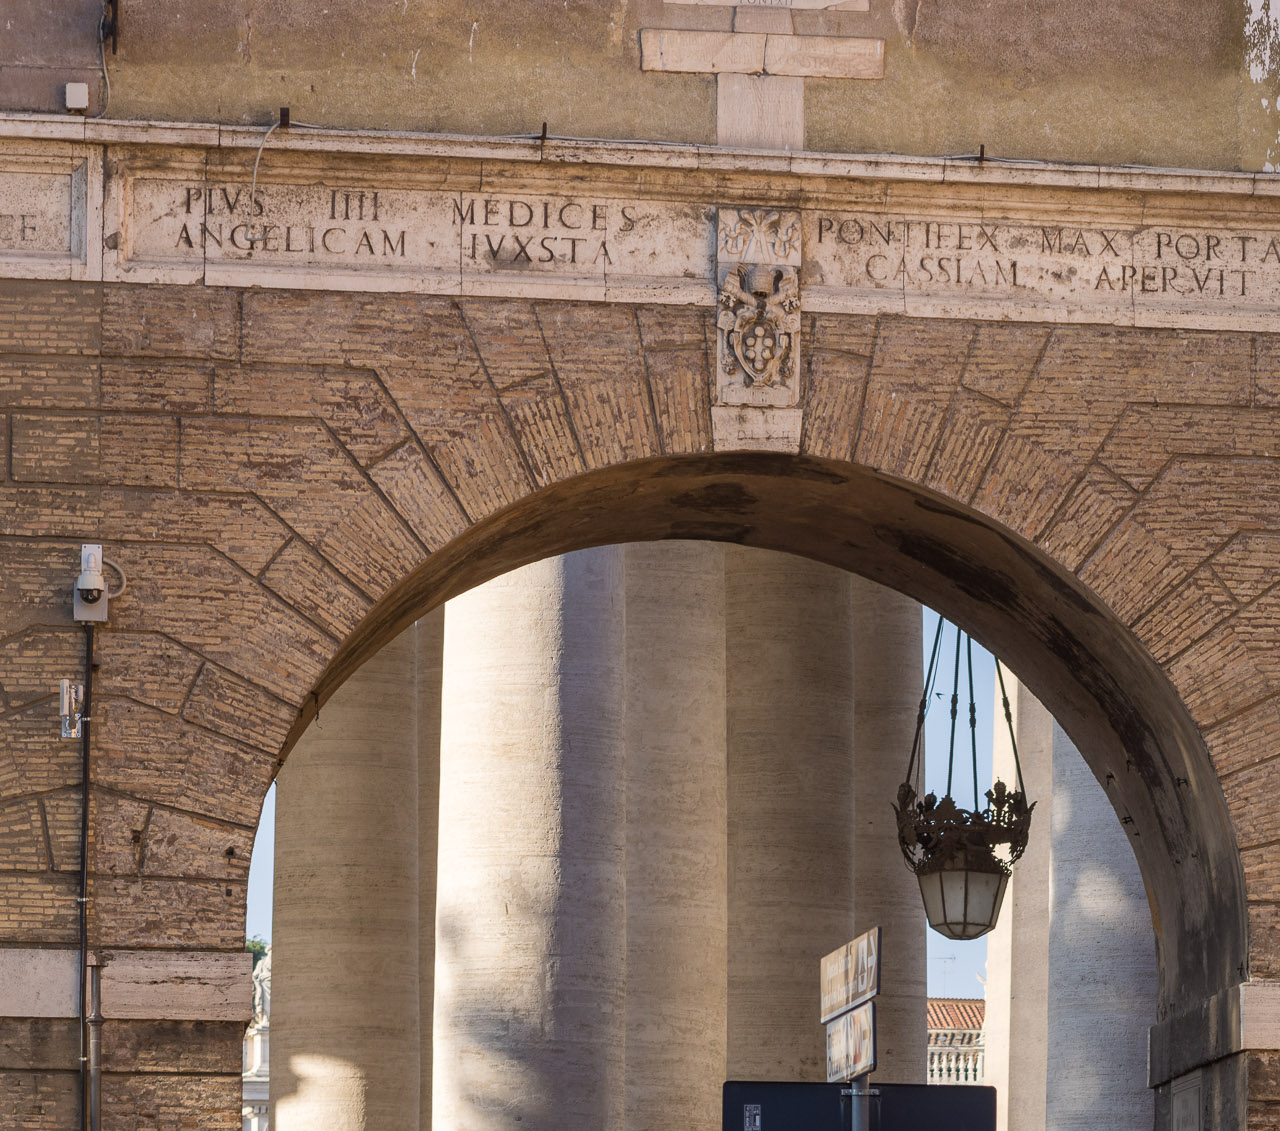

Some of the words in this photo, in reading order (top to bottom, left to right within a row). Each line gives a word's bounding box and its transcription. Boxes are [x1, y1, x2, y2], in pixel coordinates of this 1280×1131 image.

[184, 187, 264, 217] PIVS
[452, 198, 636, 232] MEDICES
[175, 222, 407, 257] ANGELICAM
[470, 233, 613, 265] IVXSTA
[817, 217, 1001, 252] PONTIFEX
[1040, 227, 1120, 257] MAX
[865, 254, 1018, 287] CASSIAM
[1095, 265, 1257, 296] APERVIT
